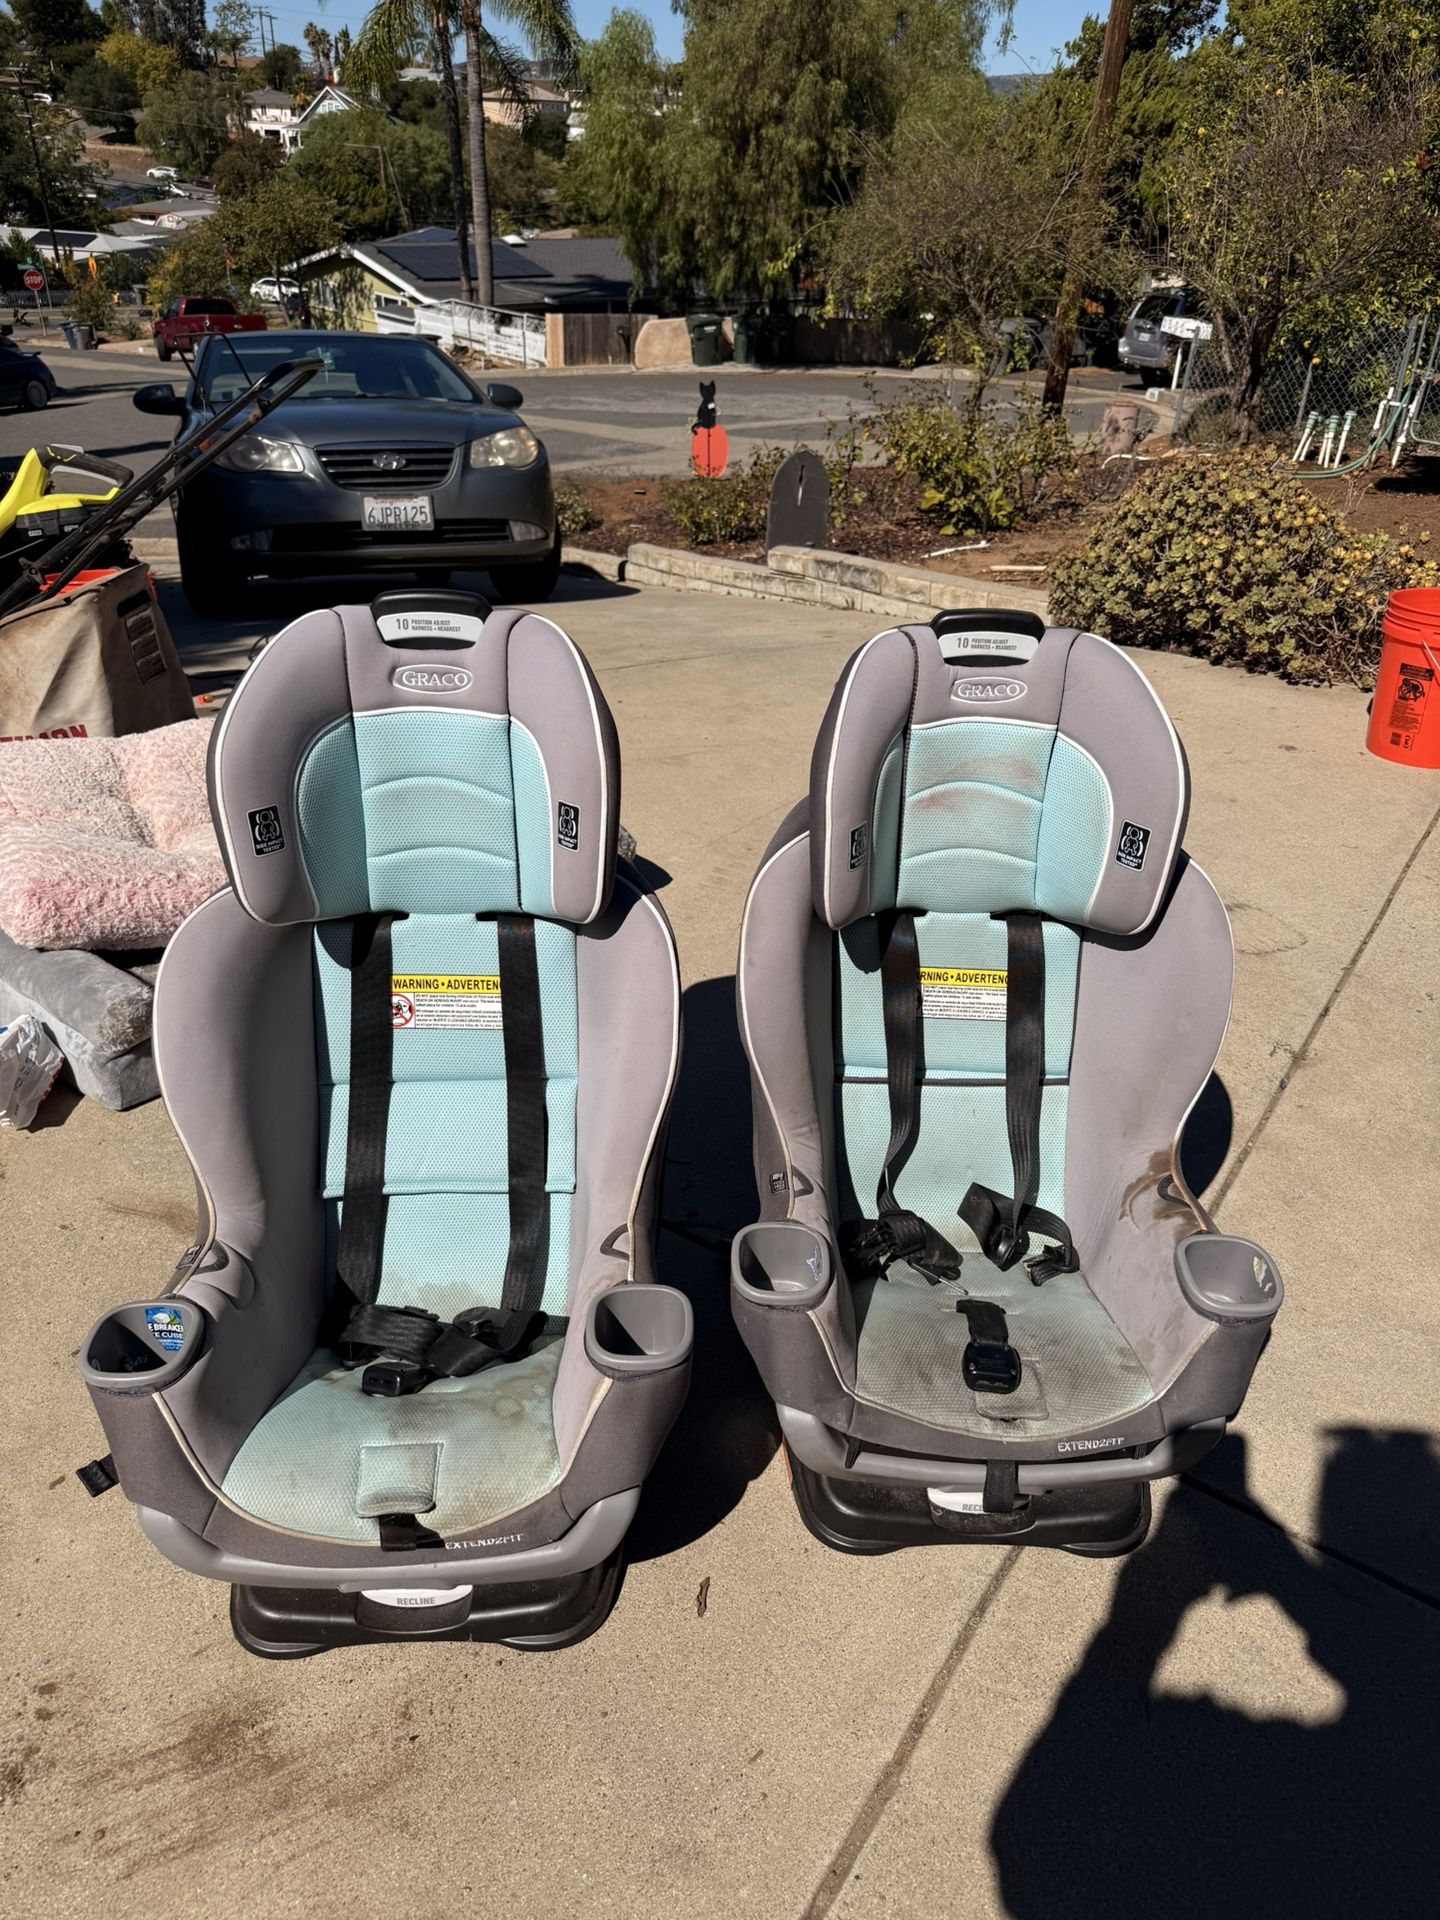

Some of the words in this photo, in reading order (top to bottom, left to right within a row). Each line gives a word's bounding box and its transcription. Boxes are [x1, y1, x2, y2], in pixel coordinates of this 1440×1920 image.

[25, 276, 42, 284] STOP
[368, 506, 428, 525] 6JPR125
[396, 618, 409, 630] 10
[957, 637, 969, 648] 10
[402, 671, 467, 686] GRACO
[958, 684, 1020, 697] GRACO
[268, 838, 283, 846] IMPACT
[921, 972, 948, 981] RNING
[955, 973, 1008, 984] ADVERTENC
[394, 979, 439, 989] WARNING
[447, 979, 500, 990] ADVERTEN
[1058, 1437, 1125, 1452] EXTEND2FIT
[962, 1503, 983, 1511] RECL
[445, 1533, 524, 1550] EXTEND2FIT
[397, 1597, 436, 1605] RECLINE
